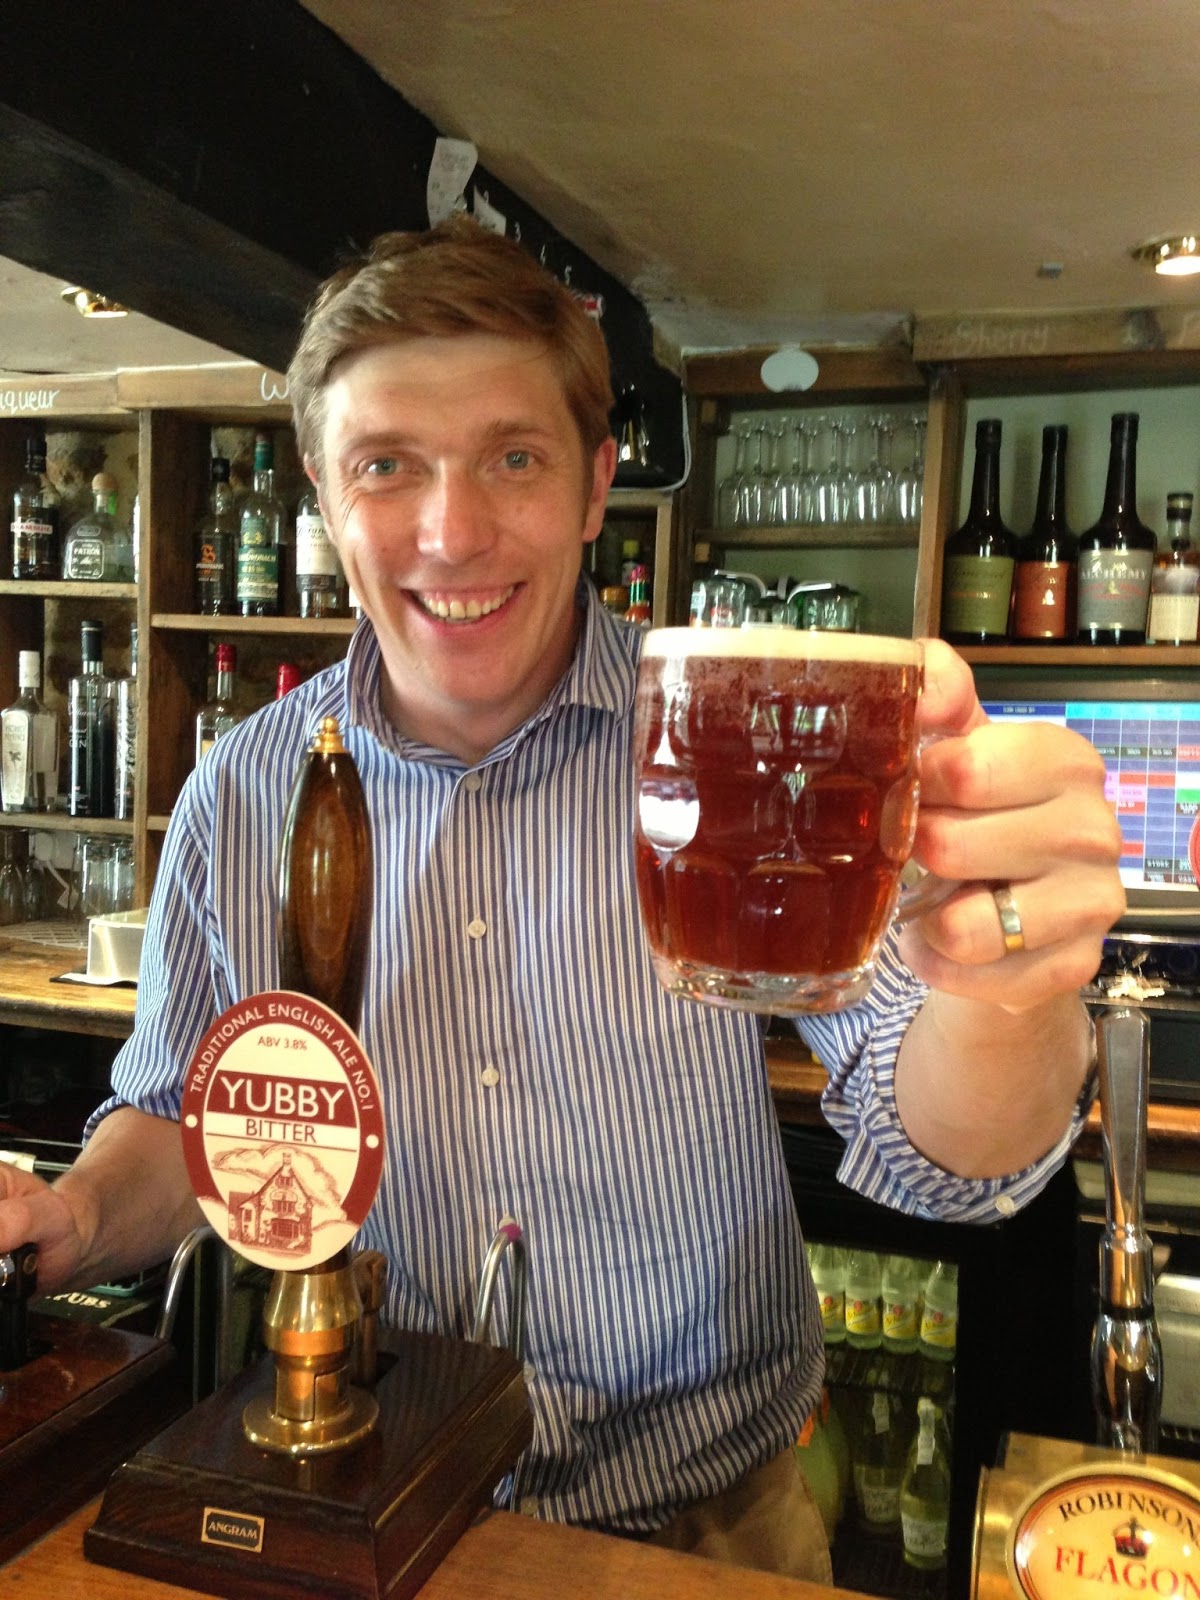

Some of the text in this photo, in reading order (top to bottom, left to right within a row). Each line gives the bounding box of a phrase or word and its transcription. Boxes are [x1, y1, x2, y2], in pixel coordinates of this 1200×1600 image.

[190, 1006, 264, 1093] TRADITIONAL
[268, 1003, 336, 1040] ENGLISH
[331, 1039, 359, 1068] ALE
[257, 1035, 308, 1051] ABV 3.8%
[219, 1076, 345, 1121] YUBBY
[245, 1118, 317, 1144] BITTER
[208, 1520, 258, 1539] ANGRAM
[1058, 1491, 1200, 1549] ROBINSON
